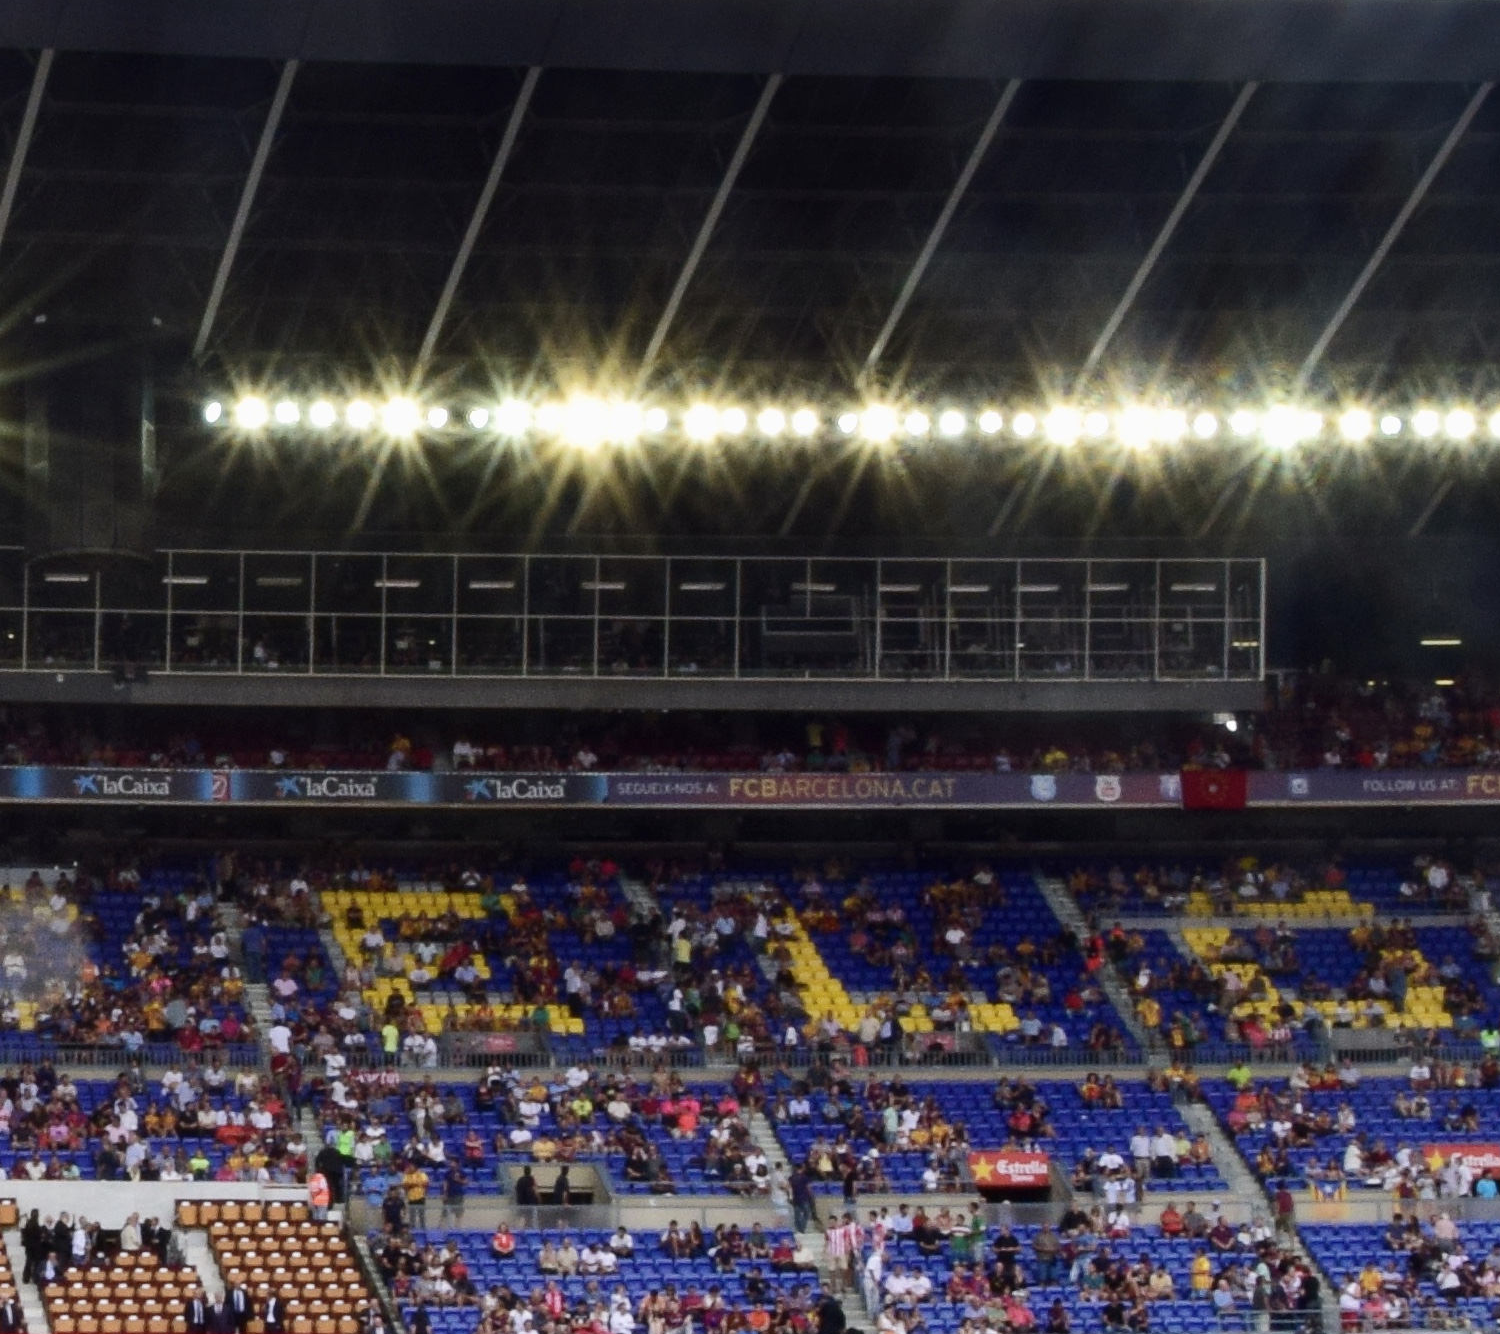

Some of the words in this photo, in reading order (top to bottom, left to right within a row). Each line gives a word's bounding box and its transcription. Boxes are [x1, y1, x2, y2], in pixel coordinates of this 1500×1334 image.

[729, 778, 956, 799] FCBARCELONA.CAT
[1363, 779, 1416, 793] FOLLOW
[1420, 779, 1437, 791] US
[997, 1160, 1048, 1175] Estrella
